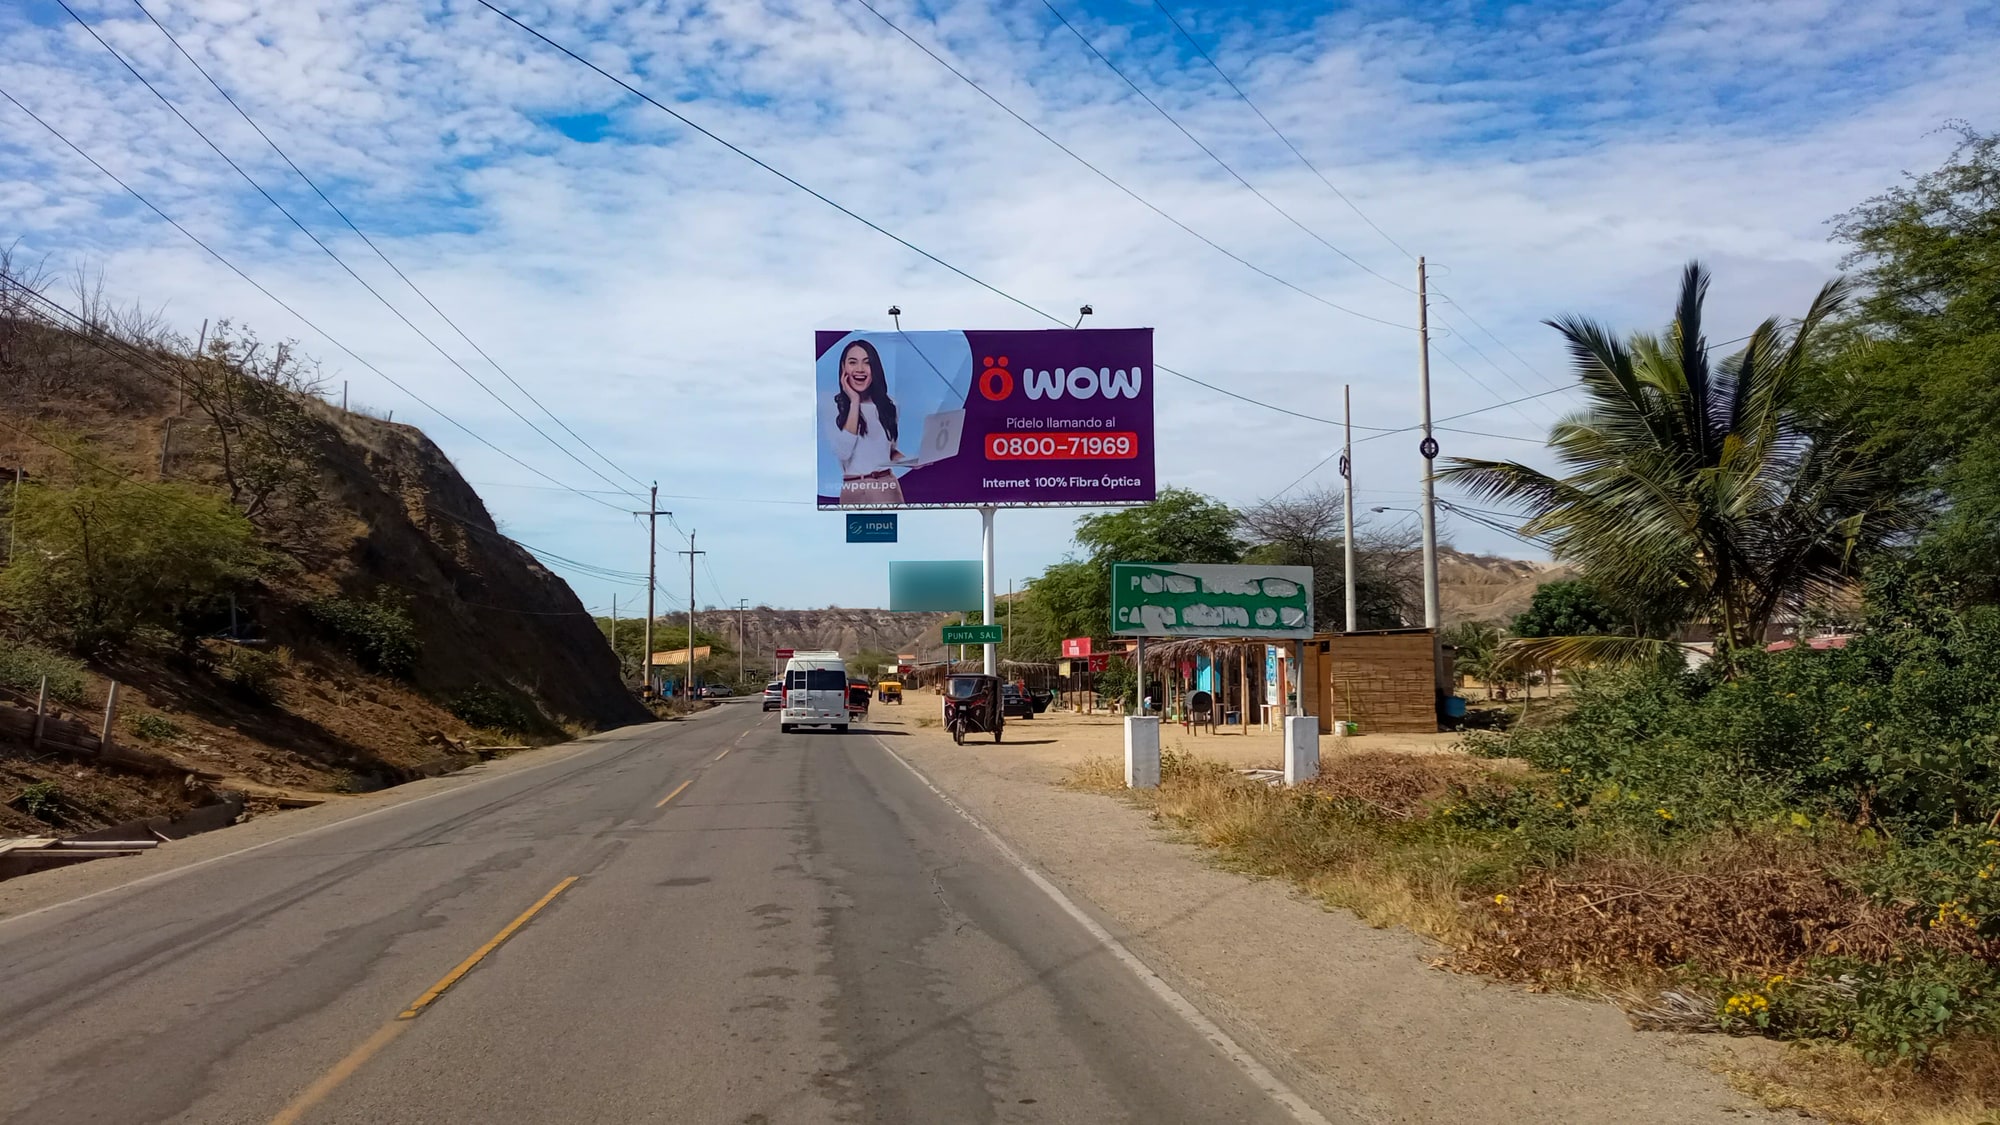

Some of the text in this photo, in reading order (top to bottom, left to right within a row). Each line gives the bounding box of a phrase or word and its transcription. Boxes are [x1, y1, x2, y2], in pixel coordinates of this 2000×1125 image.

[979, 356, 1014, 401] Ö
[1006, 416, 1115, 428] Pídelo llamando al
[993, 437, 1130, 455] 0800-71969
[826, 482, 897, 492] wperu.pe
[983, 474, 1141, 489] Internet 100% Fibra Óptica
[948, 632, 973, 640] PUNTA
